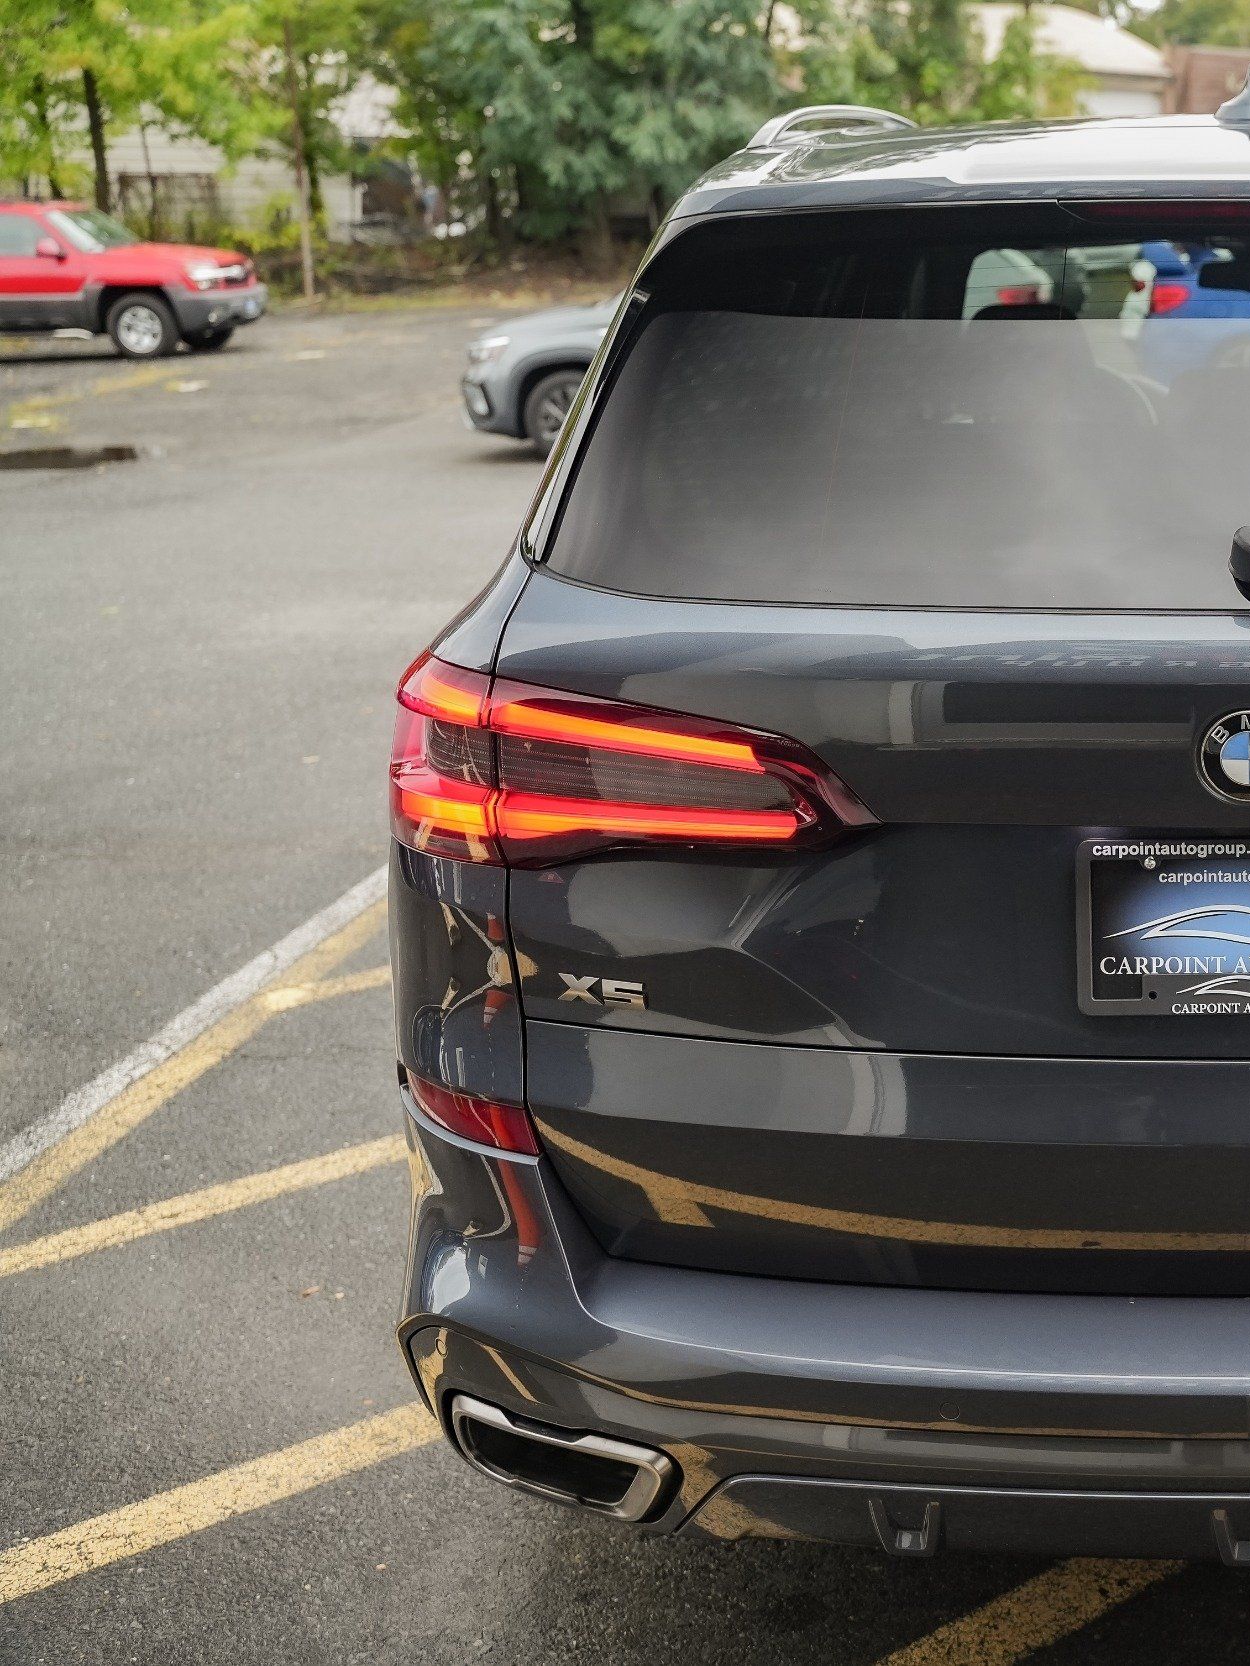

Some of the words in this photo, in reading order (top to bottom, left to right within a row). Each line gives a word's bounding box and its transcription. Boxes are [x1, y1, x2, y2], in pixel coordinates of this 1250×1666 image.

[1099, 956, 1227, 975] CARPOINT
[557, 972, 646, 1011] X5
[1171, 1003, 1241, 1014] CARPOINT
